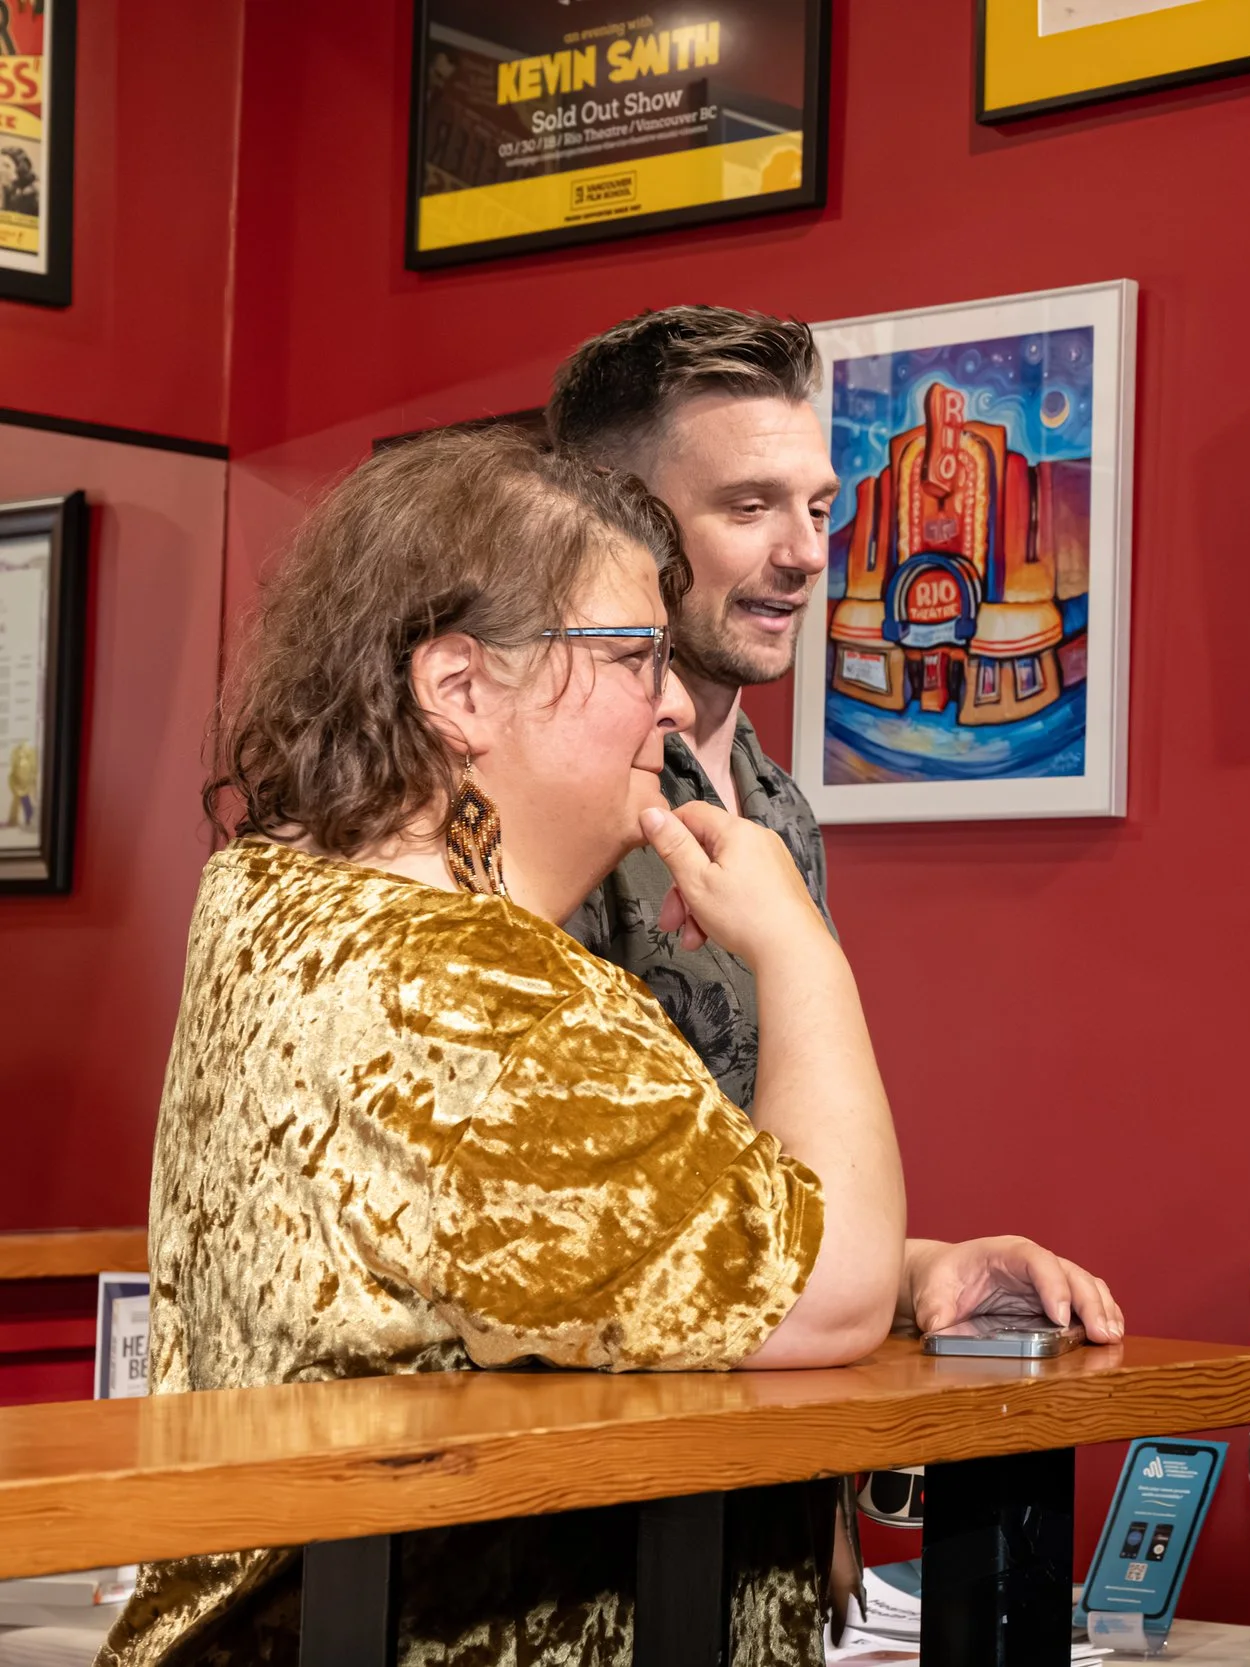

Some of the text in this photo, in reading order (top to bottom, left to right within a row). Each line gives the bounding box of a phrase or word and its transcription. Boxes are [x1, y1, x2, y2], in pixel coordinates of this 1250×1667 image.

[581, 22, 626, 40] evening
[627, 15, 654, 31] with
[497, 21, 720, 105] KEVIN SMITH
[531, 89, 684, 134] Sold Out Show
[563, 132, 583, 147] Rio
[583, 122, 629, 143] Theatre
[636, 110, 699, 133] Vancouver
[699, 105, 718, 120] BC
[942, 391, 965, 480] RIO
[910, 603, 959, 621] THEATRE
[915, 578, 957, 606] RIO
